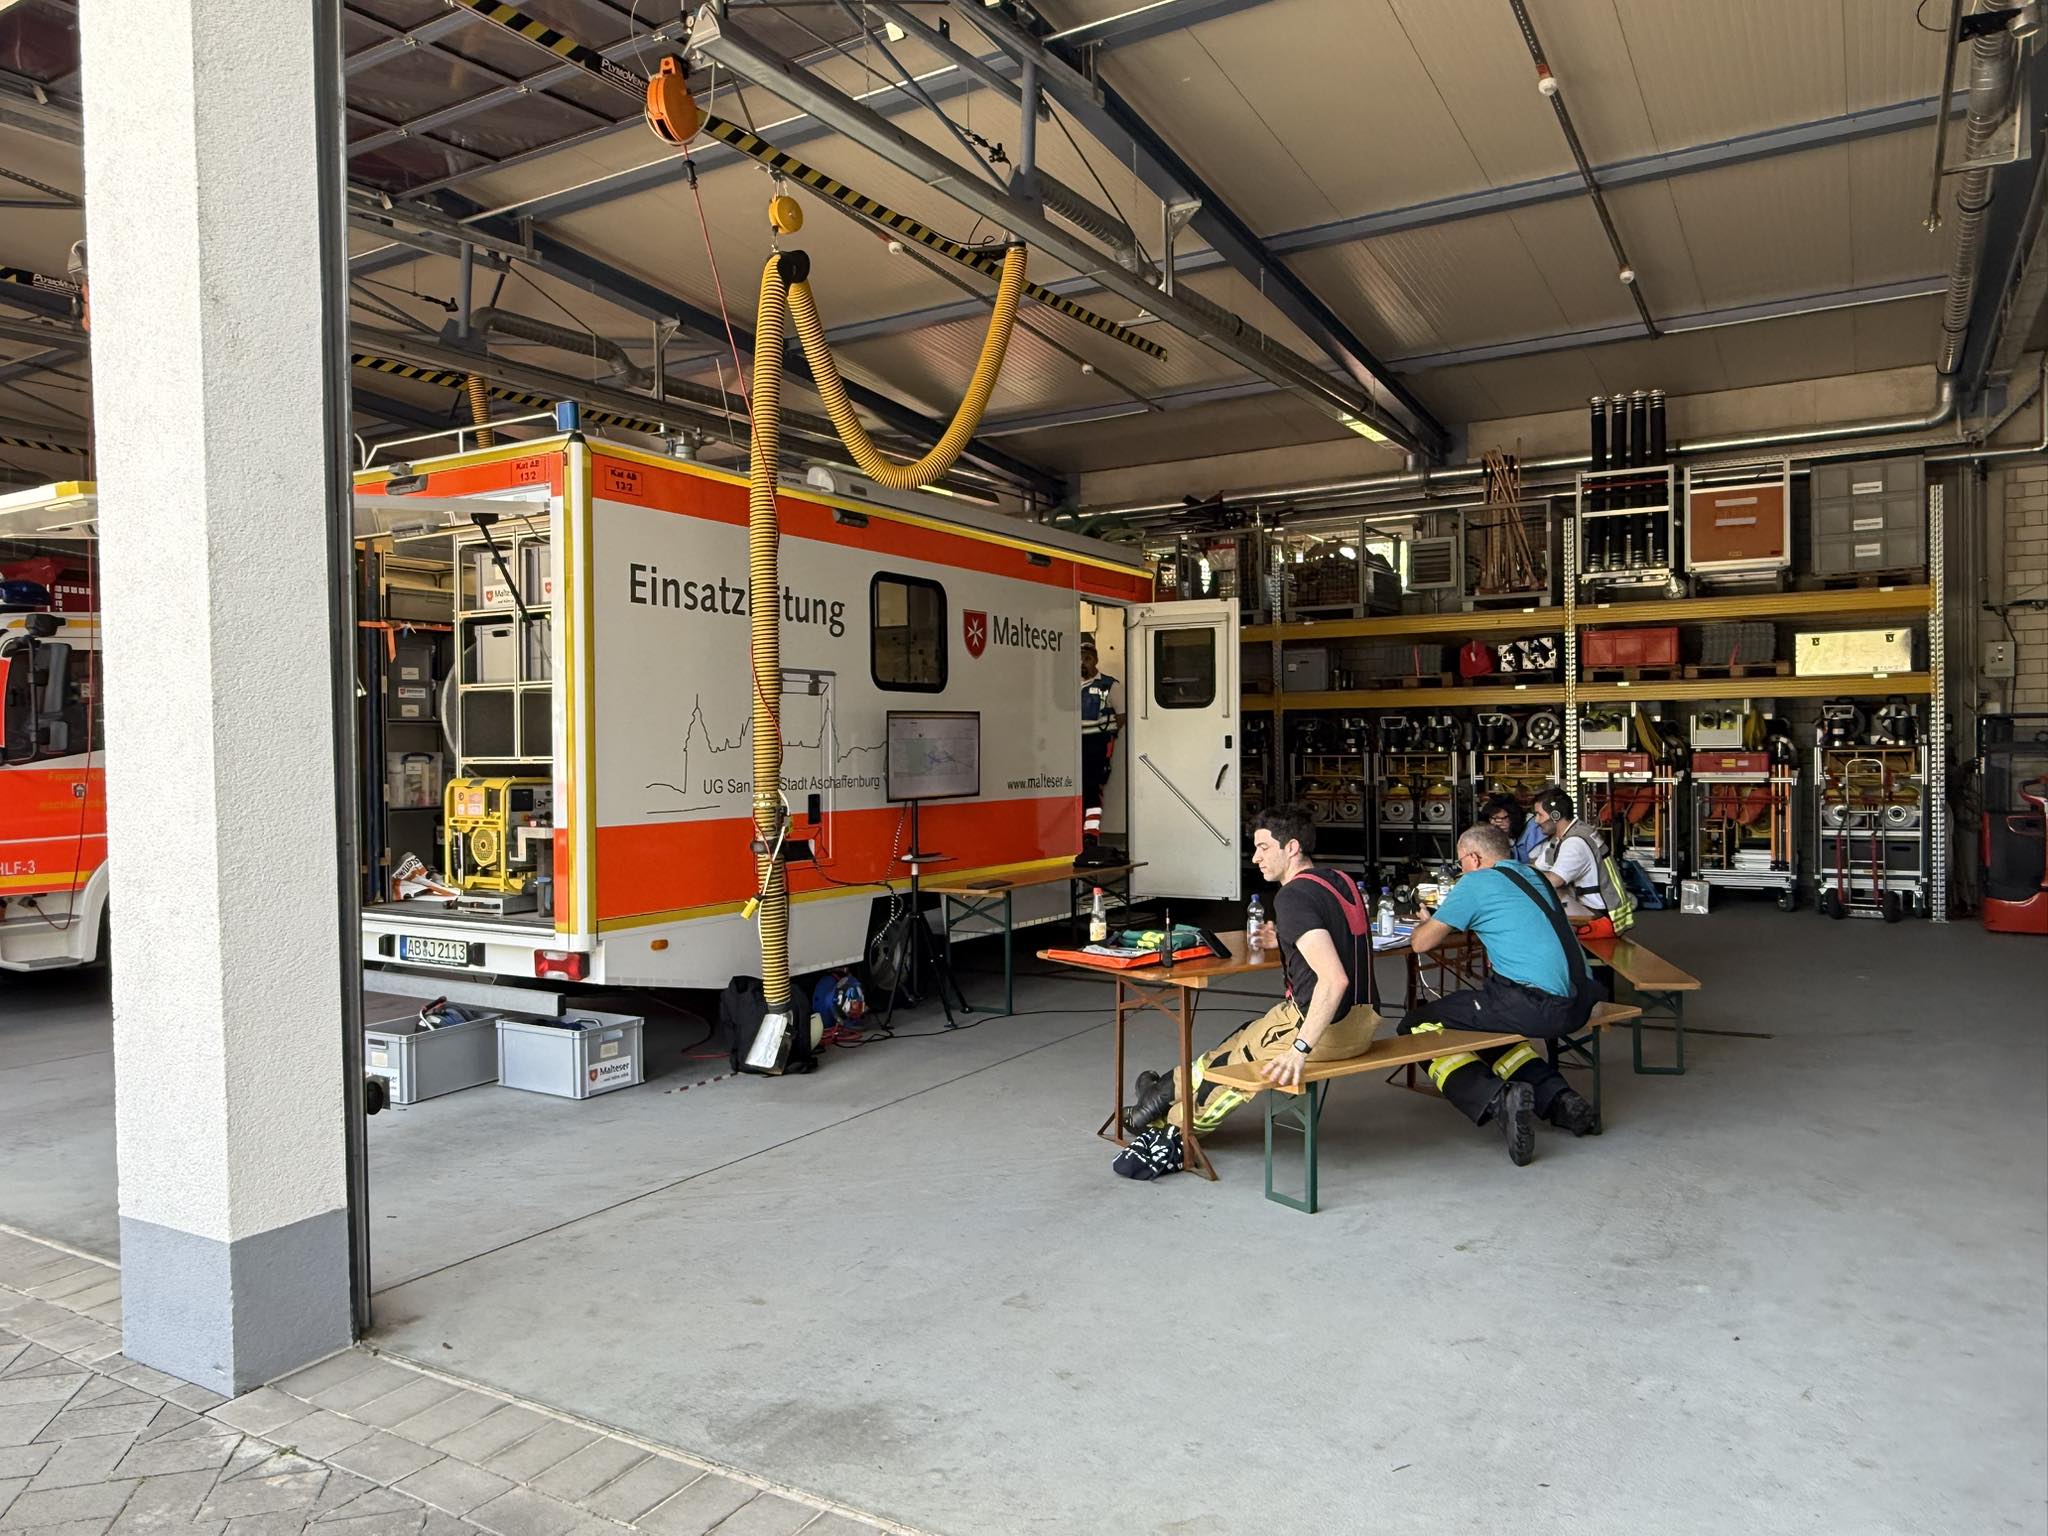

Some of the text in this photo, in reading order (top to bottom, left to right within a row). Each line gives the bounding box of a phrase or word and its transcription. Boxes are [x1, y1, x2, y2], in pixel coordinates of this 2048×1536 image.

[630, 563, 845, 638] Einsatztung
[993, 615, 1063, 652] Malteser
[703, 779, 723, 794] UG
[779, 776, 807, 791] Stadt
[809, 774, 880, 790] Aschaffenburg
[408, 939, 421, 956] AB
[437, 943, 466, 960] 2113
